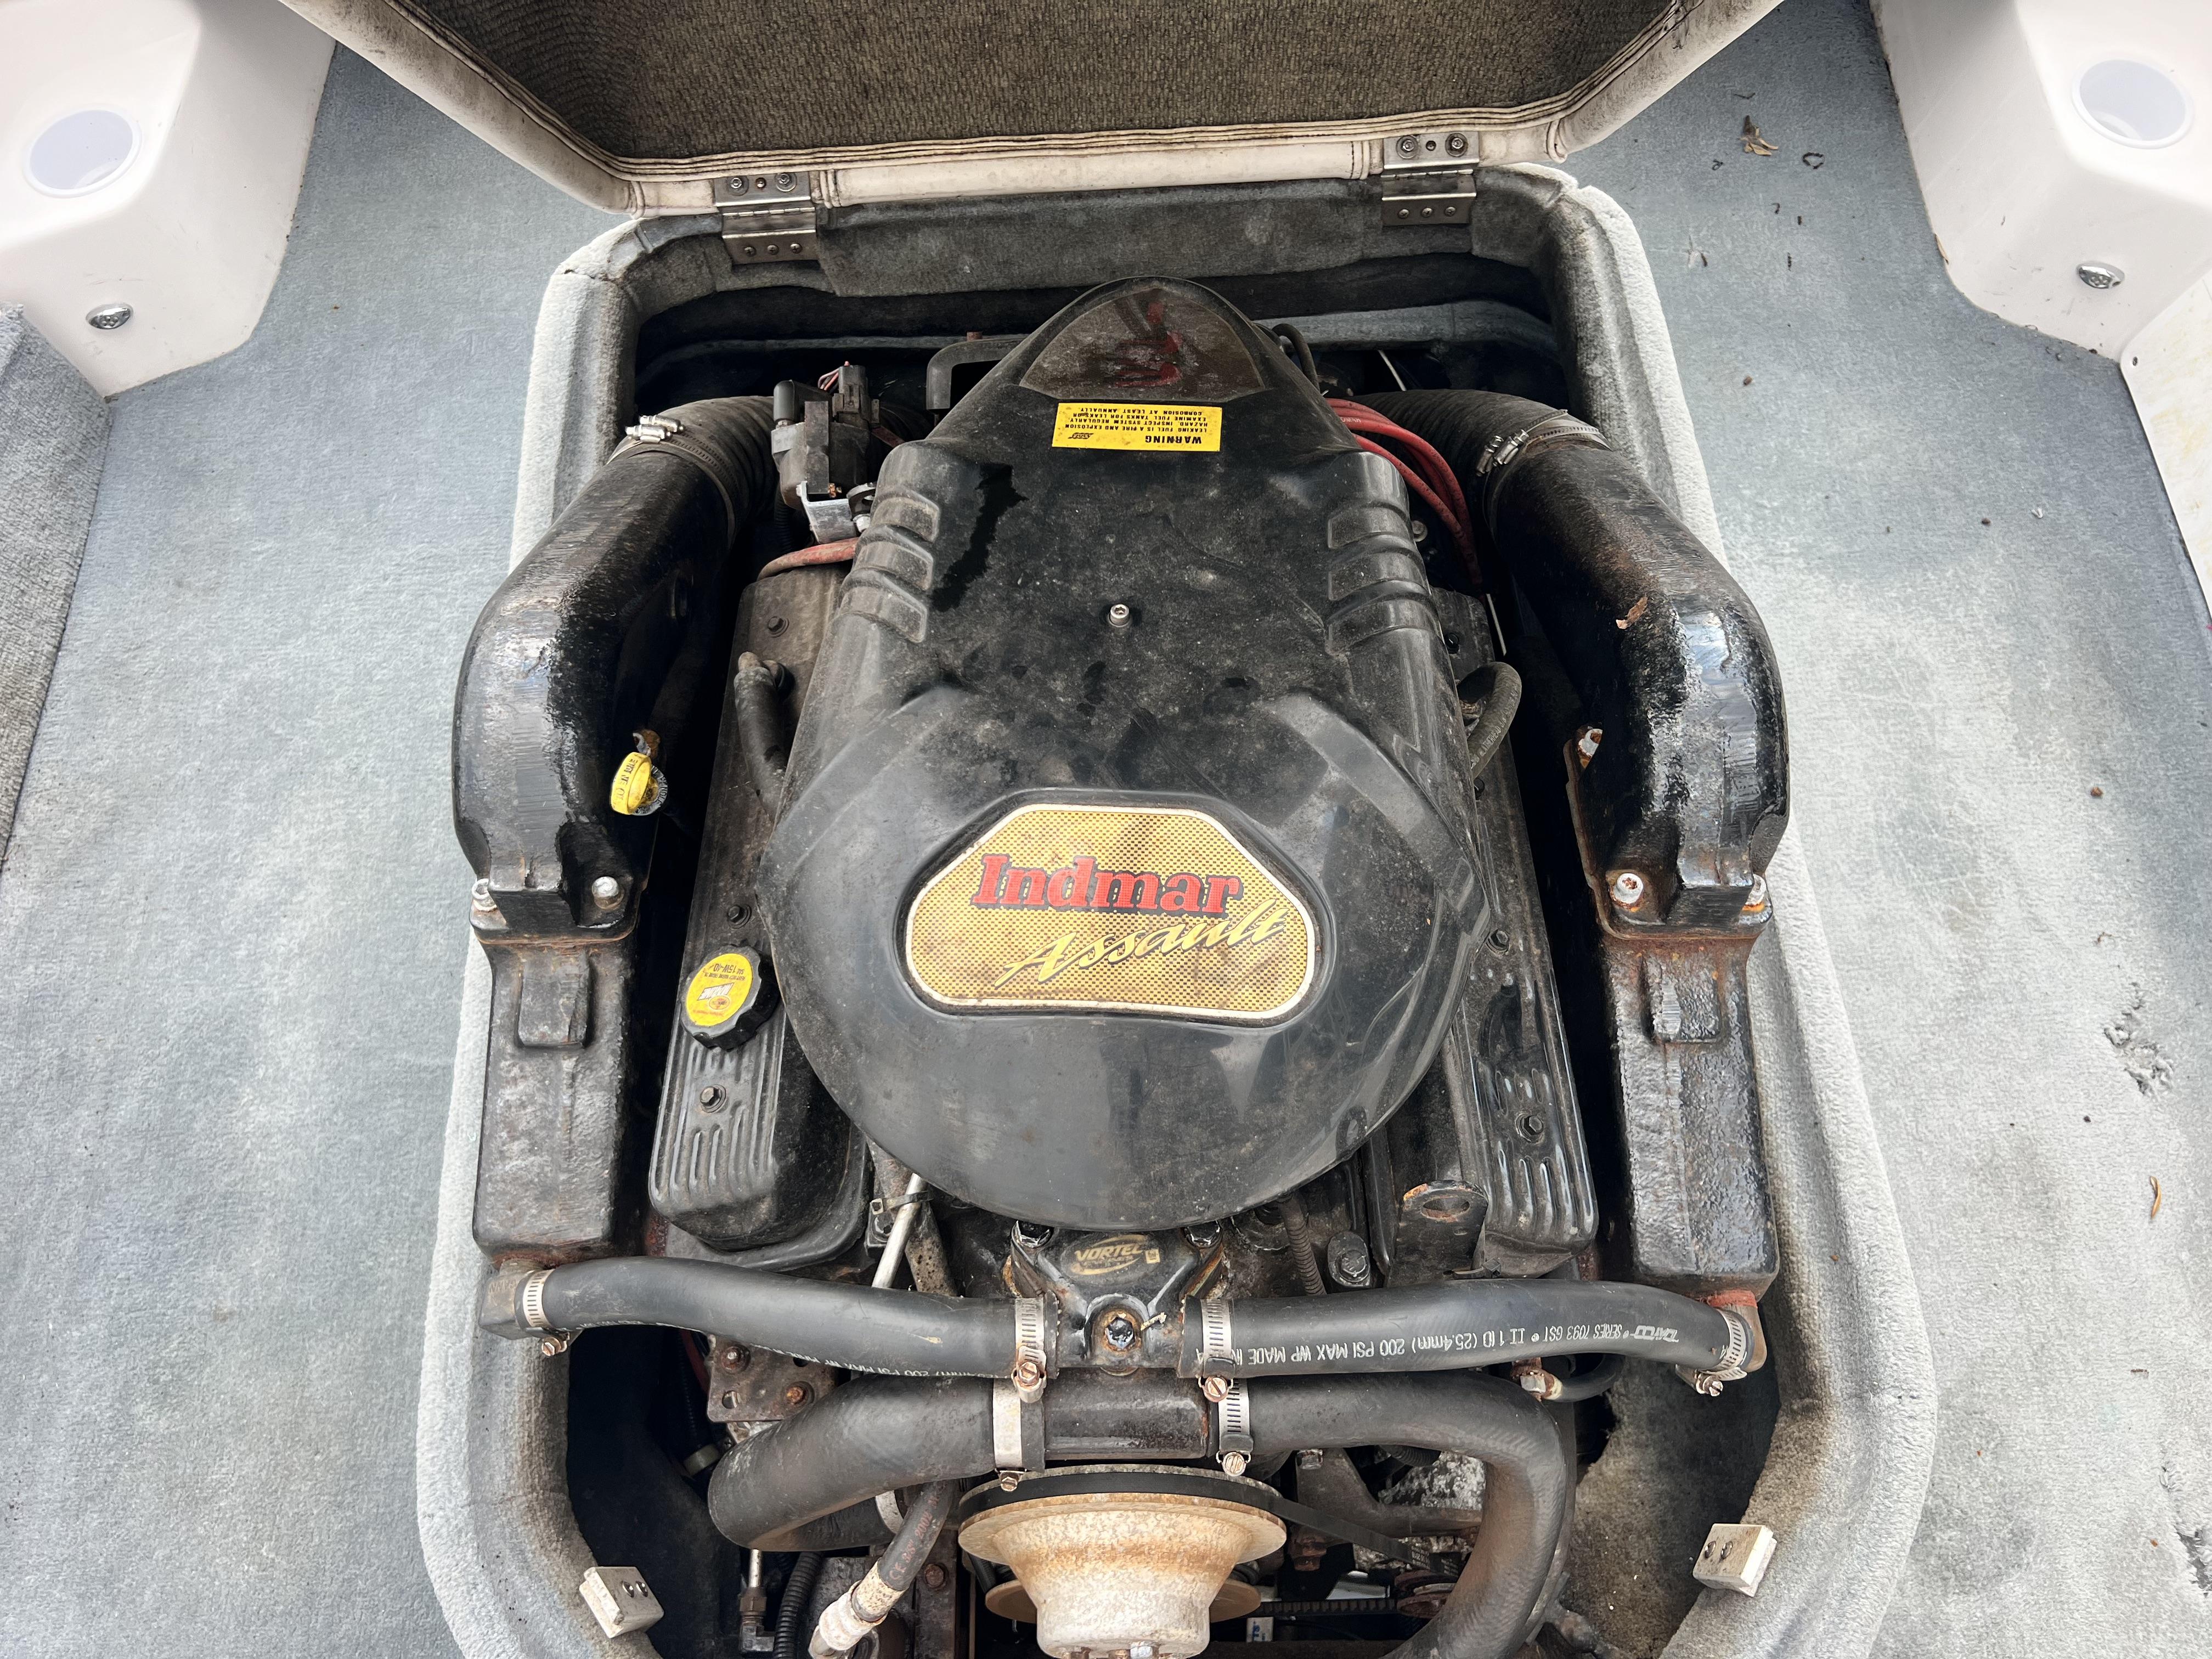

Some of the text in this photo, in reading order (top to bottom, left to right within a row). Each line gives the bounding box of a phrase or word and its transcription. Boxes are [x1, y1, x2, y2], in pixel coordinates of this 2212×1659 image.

[1145, 436, 1202, 444] WARNING
[972, 854, 1243, 917] Indmar
[995, 899, 1290, 988] Assault
[713, 963, 737, 973] 15W-40
[1482, 1330, 1496, 1348] ID
[1499, 1330, 1505, 1347] 1
[1509, 1328, 1525, 1345] II
[1566, 1324, 1590, 1341] 7093
[1593, 1323, 1623, 1340] SERIES
[1316, 1342, 1348, 1361] MAX
[1352, 1341, 1375, 1359] PSI
[1380, 1338, 1405, 1357] 200
[1412, 1332, 1478, 1353] (25.4mm)
[1248, 1346, 1286, 1365] MADE
[1290, 1345, 1312, 1362] WP
